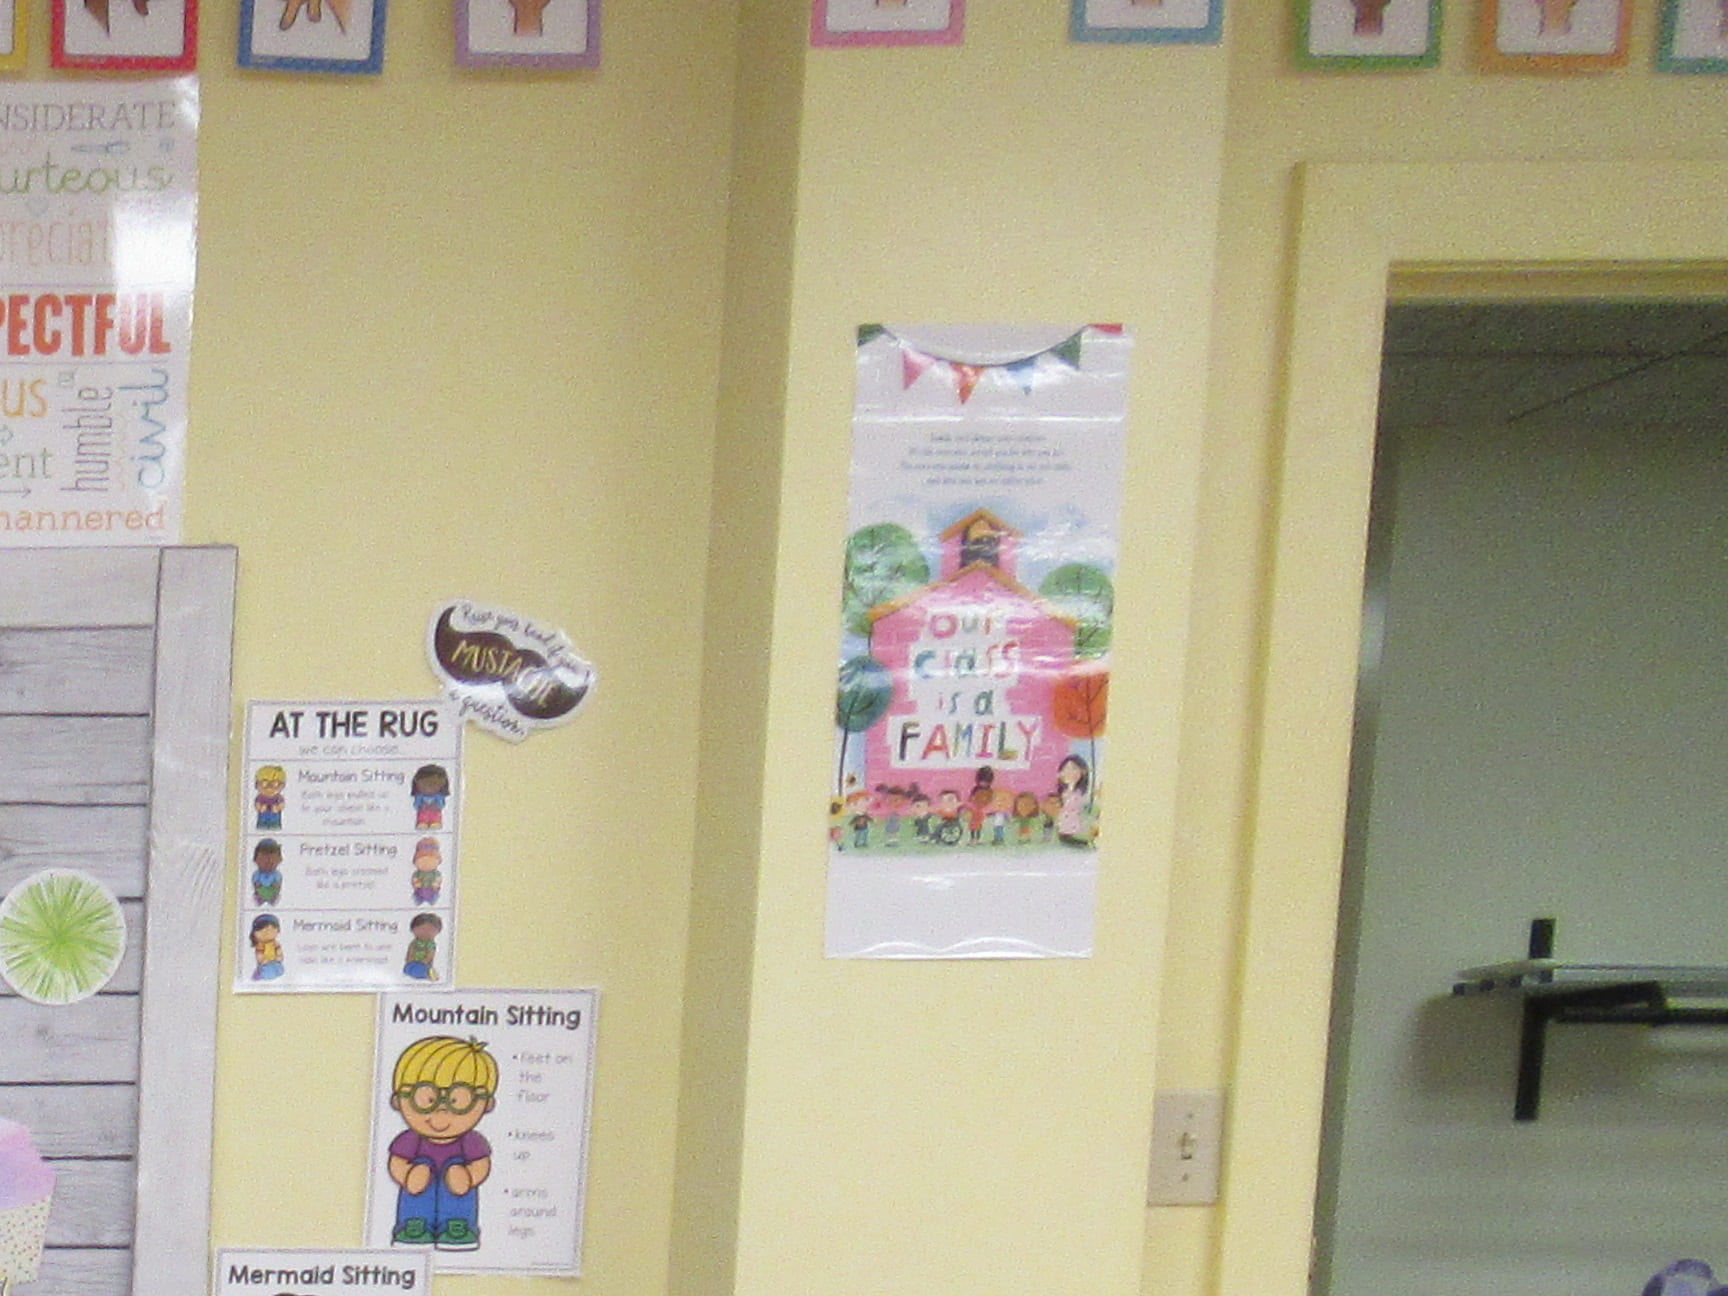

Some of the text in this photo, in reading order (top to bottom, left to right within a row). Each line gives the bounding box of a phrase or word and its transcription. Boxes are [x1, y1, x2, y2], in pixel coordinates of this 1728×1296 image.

[61, 384, 114, 494] humble
[268, 710, 302, 739] AT
[315, 710, 369, 738] THE
[380, 709, 440, 739] RUG
[898, 721, 1042, 761] FAMILY
[297, 769, 405, 786] Mountain Sitting
[299, 843, 398, 859] Pretzel Sitting
[392, 1003, 582, 1030] Mountain Sitting
[228, 1263, 417, 1291] Mermaid Sitting
